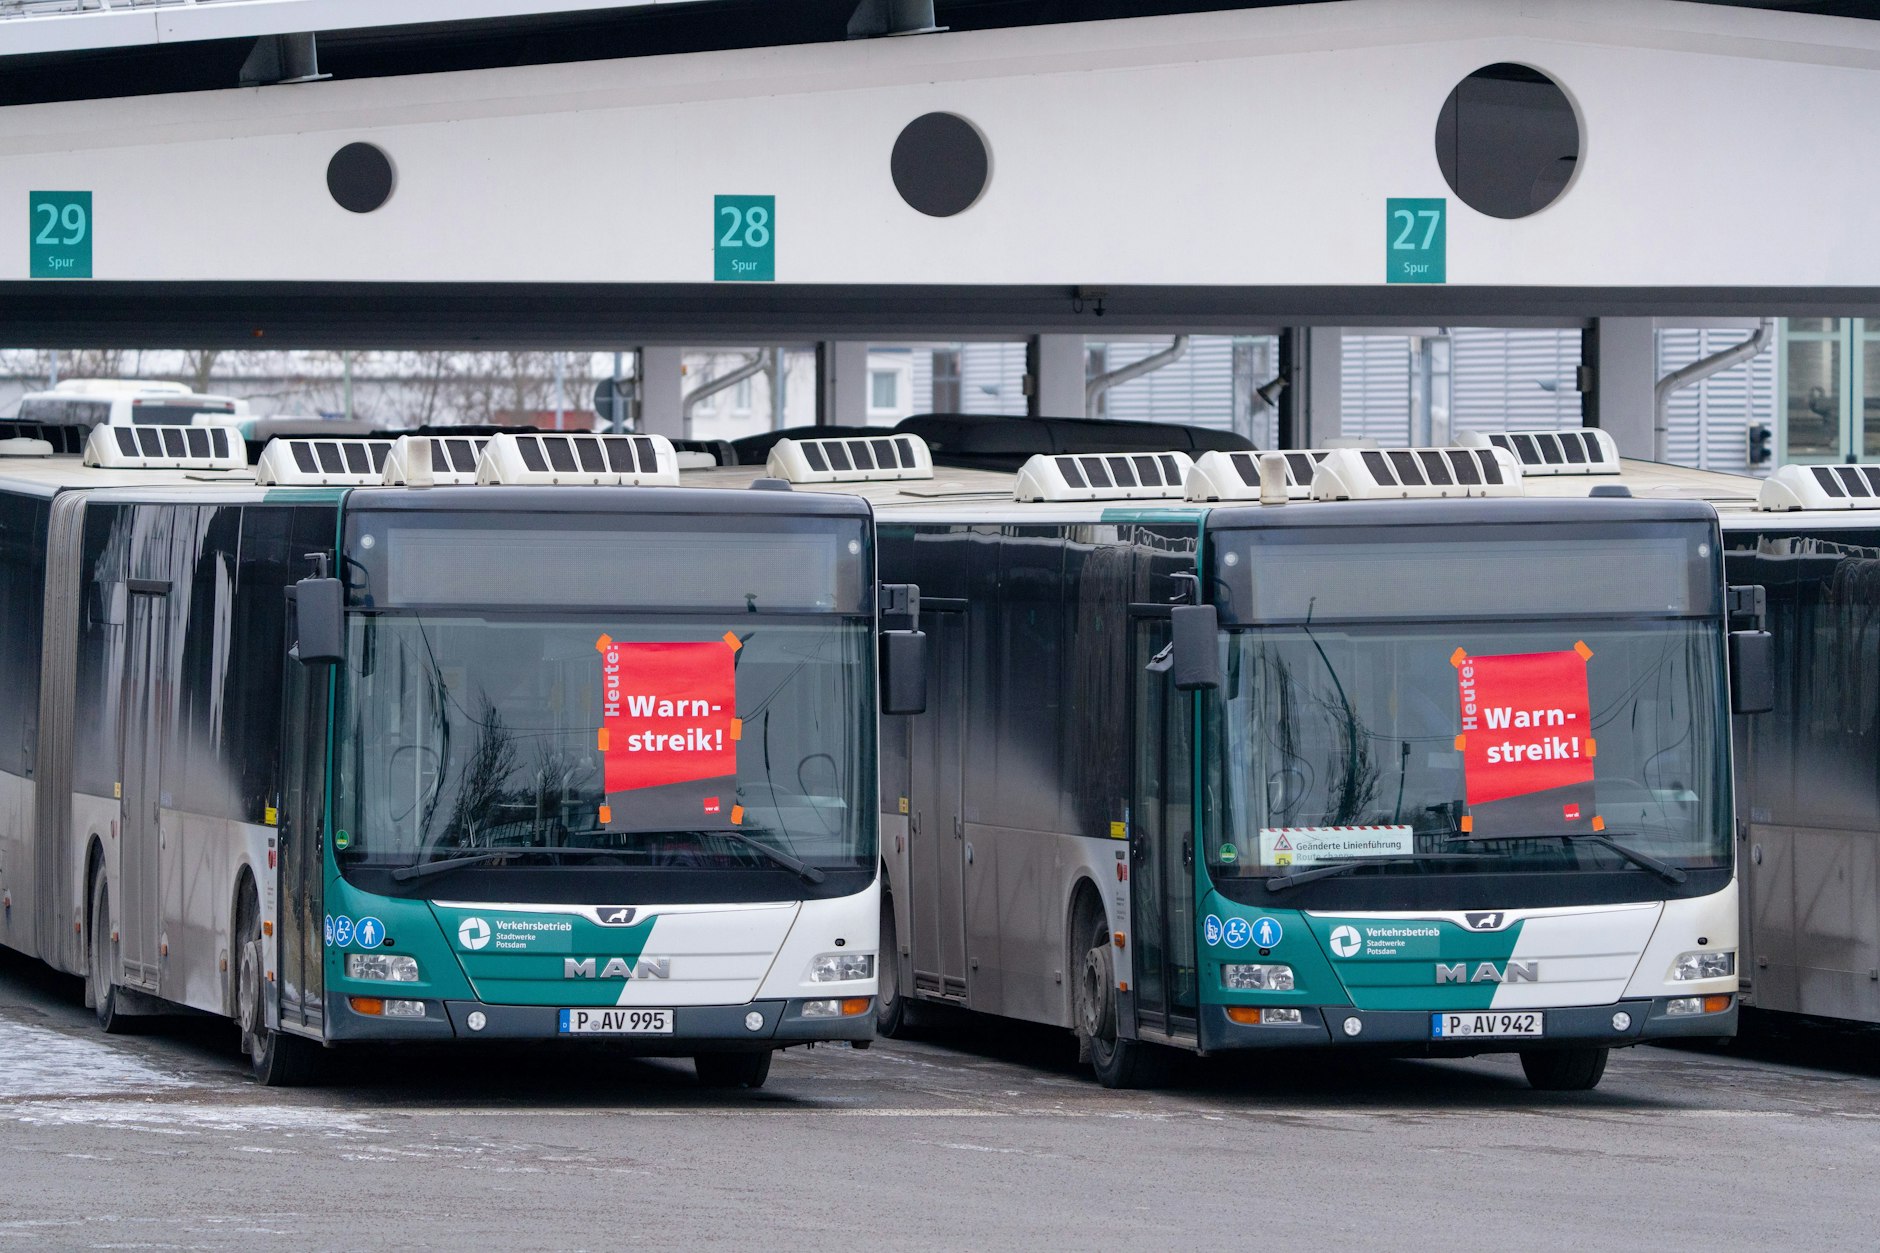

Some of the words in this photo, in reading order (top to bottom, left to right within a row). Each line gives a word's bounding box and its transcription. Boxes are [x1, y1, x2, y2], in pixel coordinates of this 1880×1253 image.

[36, 203, 86, 245] 29
[720, 206, 770, 248] 28
[1393, 209, 1440, 250] 27
[48, 256, 75, 270] Spur
[731, 259, 758, 273] Spur
[1403, 262, 1429, 276] Spur
[604, 645, 620, 717] Heute:
[1461, 659, 1478, 731] Heute:
[627, 695, 722, 718] Warn-
[1484, 707, 1577, 730] Warn-
[628, 728, 723, 752] streik!
[1487, 736, 1579, 764] streik!
[1296, 841, 1341, 851] Geänderte
[1343, 840, 1402, 851] Linienführung
[1296, 853, 1321, 861] Route
[344, 920, 351, 931] 2
[496, 920, 572, 931] Verkehrsbetrieb
[1239, 922, 1247, 933] 2
[1366, 927, 1440, 937] Verkehrsbetrieb
[496, 932, 536, 941] Stadtwerke
[496, 940, 527, 949] Potsdam
[1366, 939, 1406, 947] Stadtwerke
[1366, 947, 1397, 955] Potsdam
[564, 957, 670, 979] MAN
[1435, 961, 1538, 984] MAN
[577, 1011, 589, 1029] P
[601, 1012, 626, 1029] AV
[630, 1011, 665, 1029] 995
[1450, 1016, 1461, 1034] P
[1473, 1016, 1497, 1033] AV
[1501, 1014, 1535, 1033] 942
